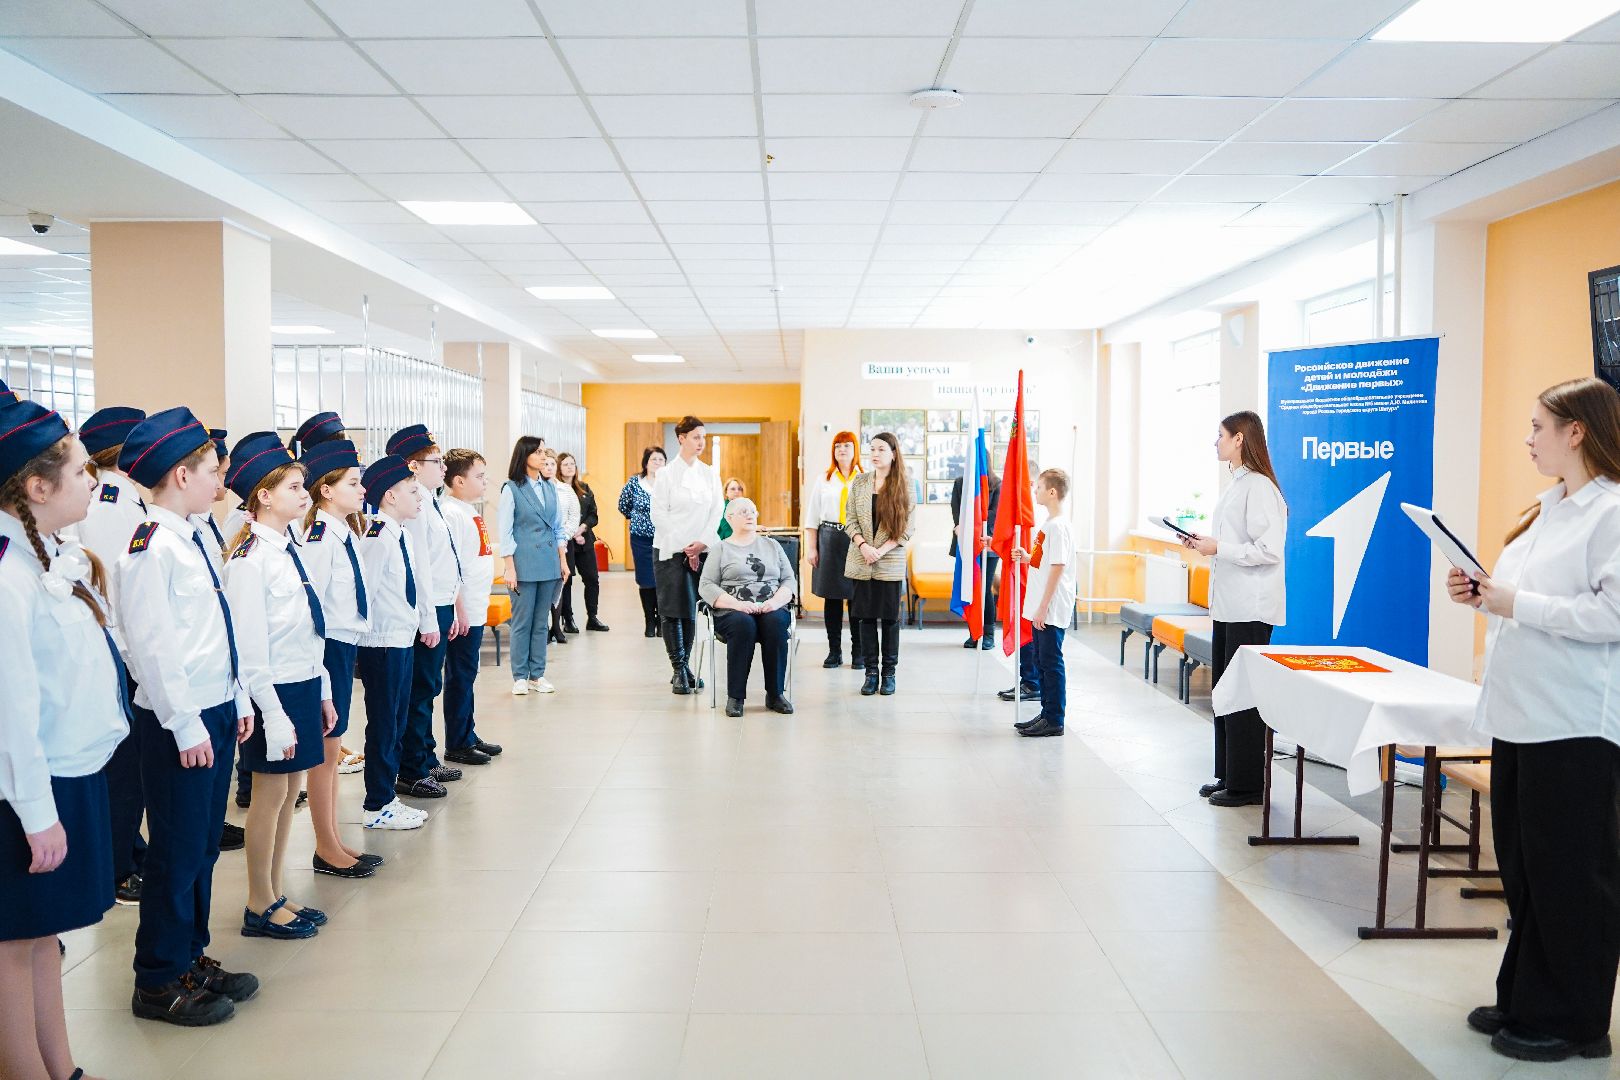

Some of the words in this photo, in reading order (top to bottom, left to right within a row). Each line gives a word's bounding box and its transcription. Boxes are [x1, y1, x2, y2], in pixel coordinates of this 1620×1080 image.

[868, 364, 903, 374] Ваши
[906, 366, 950, 377] успехи
[1294, 362, 1353, 373] Российское
[1355, 358, 1410, 369] движение
[1304, 372, 1334, 382] детей
[1343, 368, 1398, 380] молодёжи
[1300, 382, 1357, 392] «Движение
[1359, 379, 1404, 390] первых»
[1302, 436, 1395, 467] Первые
